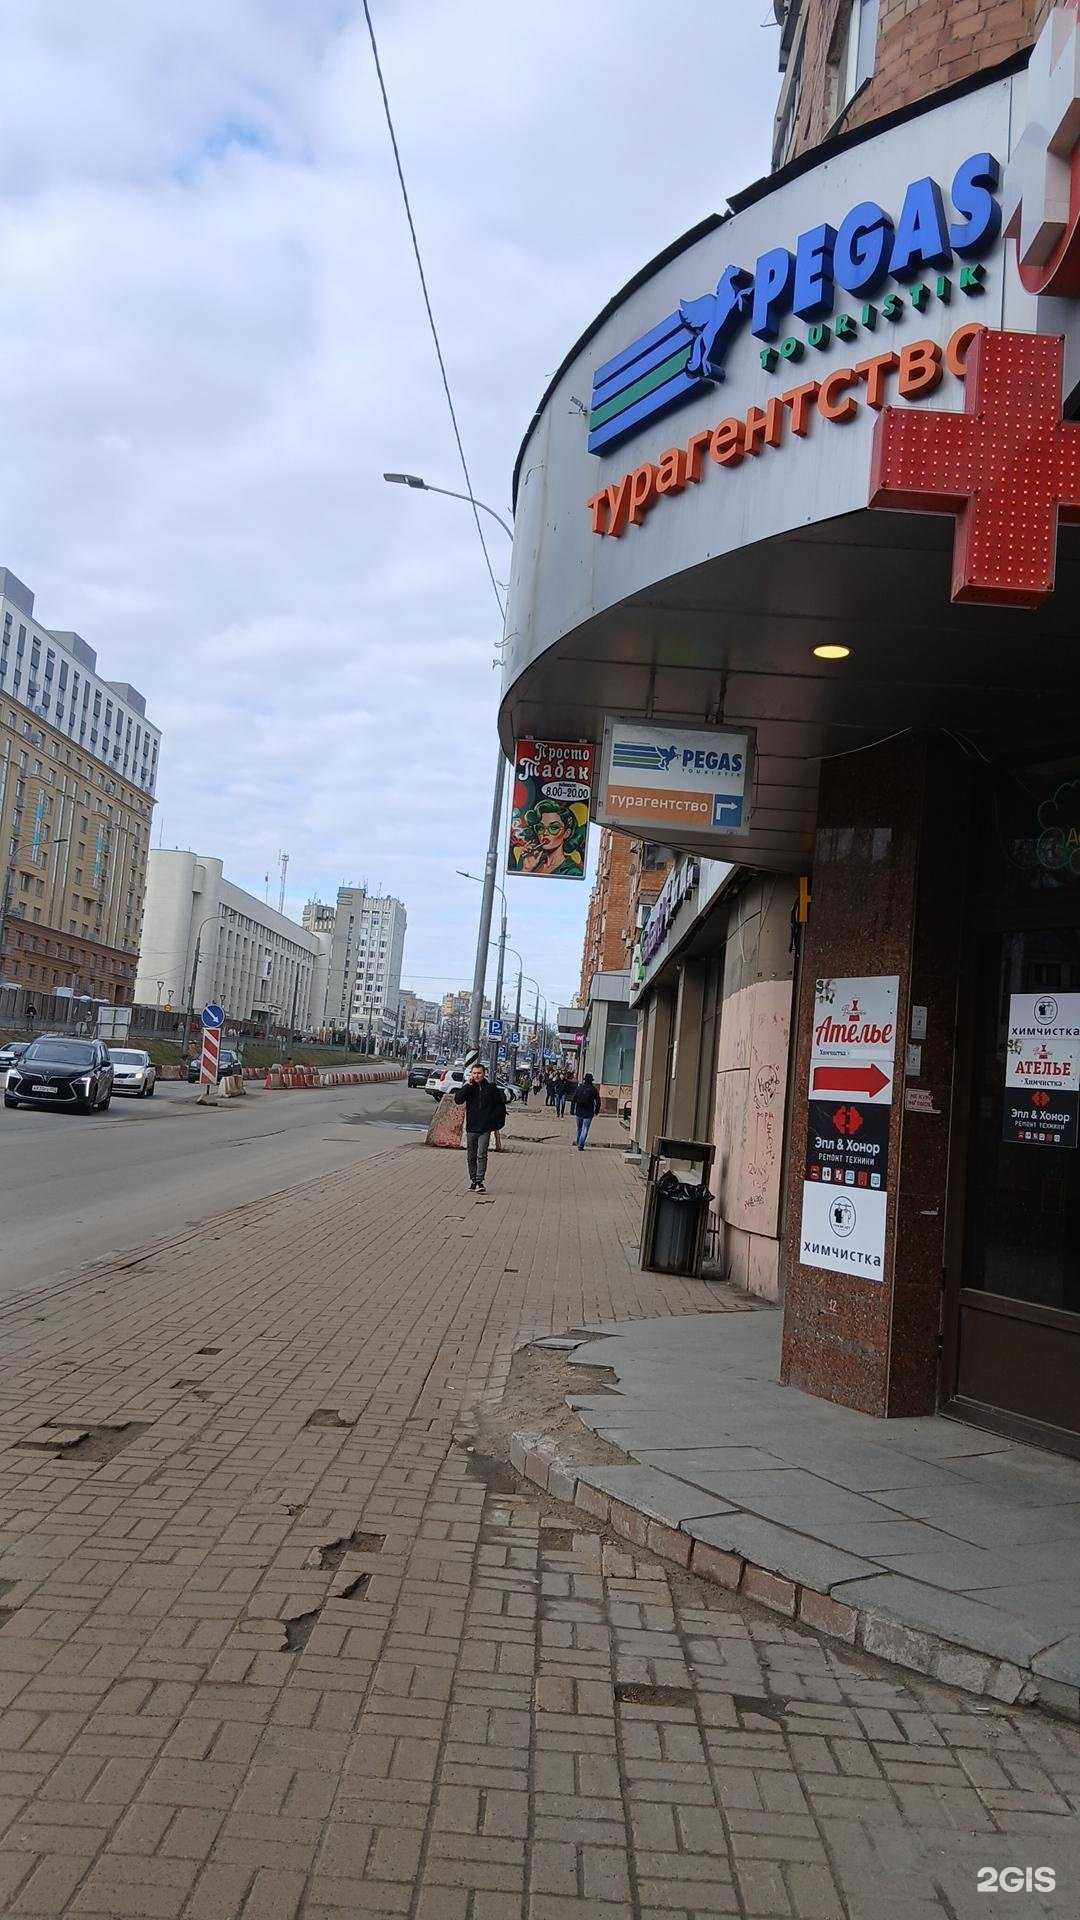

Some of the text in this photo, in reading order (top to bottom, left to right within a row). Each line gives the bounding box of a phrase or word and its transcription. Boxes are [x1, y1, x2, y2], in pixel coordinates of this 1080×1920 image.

[751, 152, 1000, 342] PEGAS
[759, 263, 987, 374] TOURISTIK
[534, 742, 590, 761] Просто
[682, 749, 743, 772] PEGAS
[518, 757, 589, 781] Табак
[610, 794, 709, 813] турагентство
[815, 1015, 893, 1047] Ателье
[1011, 1027, 1080, 1036] химчистка
[1015, 1060, 1071, 1076] АТЕЛЬЕ
[1011, 1108, 1070, 1124] Эпл & Хонор
[814, 1136, 881, 1157] Эпл & Хонор
[818, 1152, 875, 1166] РЕМОНТ ТЕХНИКИ
[803, 1241, 881, 1267] химчистка
